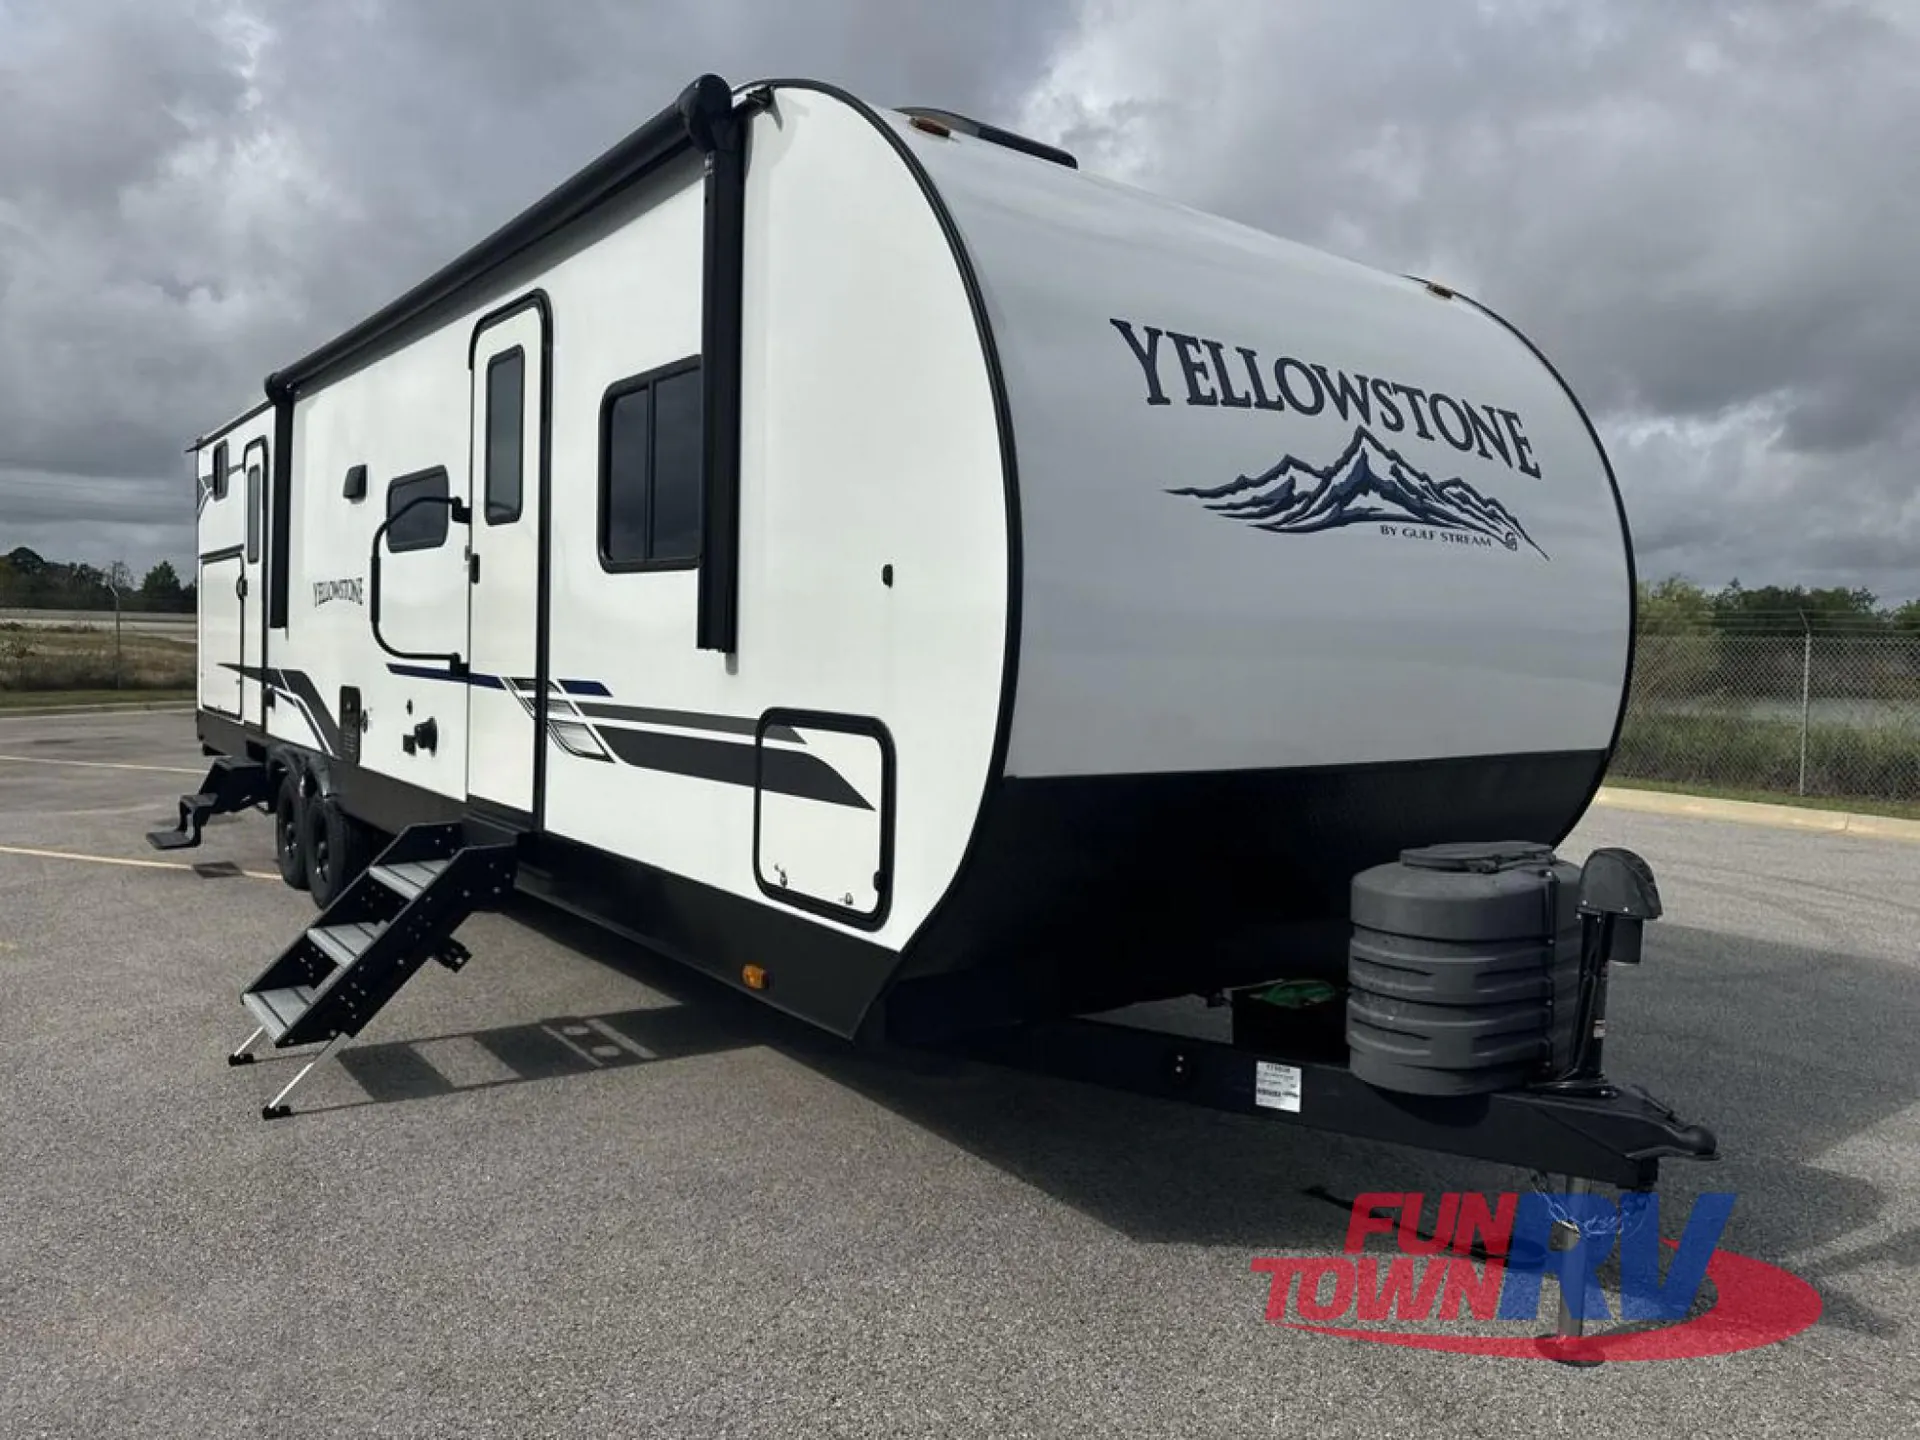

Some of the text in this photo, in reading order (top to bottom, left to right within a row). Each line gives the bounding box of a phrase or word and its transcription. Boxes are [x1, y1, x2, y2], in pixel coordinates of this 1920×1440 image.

[1110, 318, 1542, 480] YELLOWSTONE
[1380, 524, 1492, 547] BY GULF STREAM
